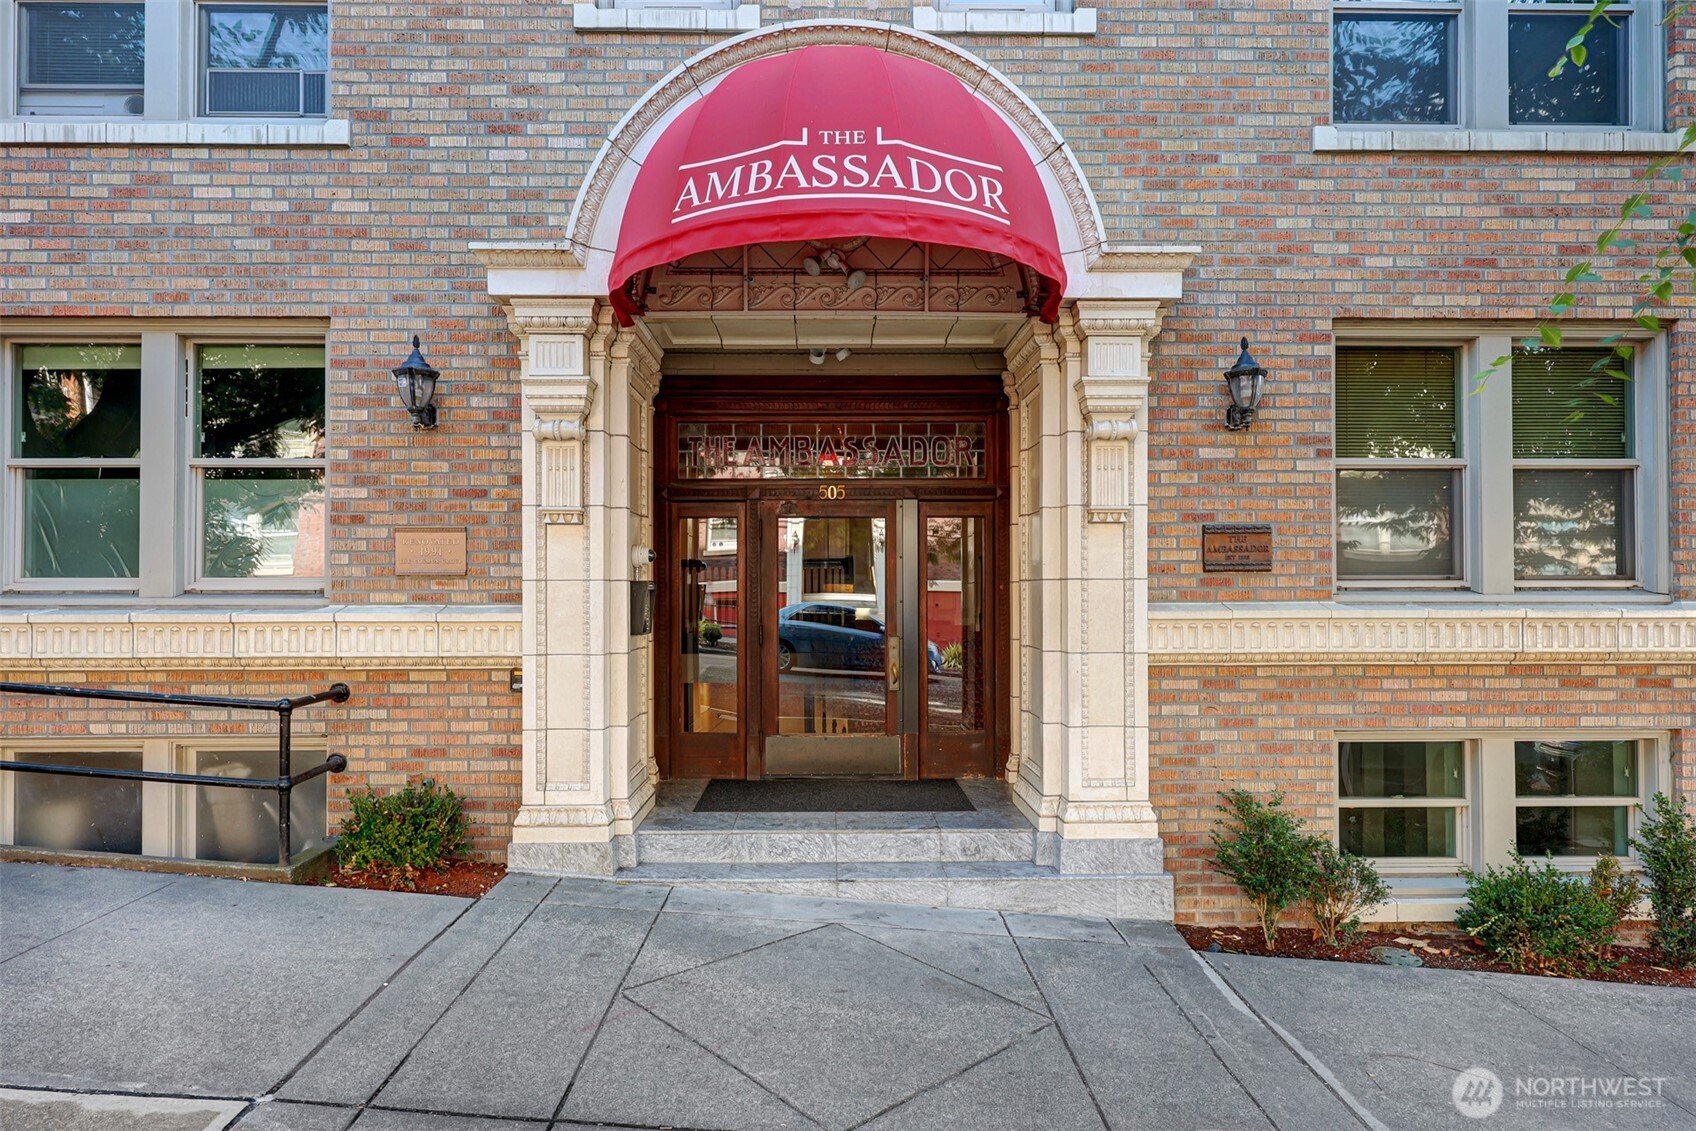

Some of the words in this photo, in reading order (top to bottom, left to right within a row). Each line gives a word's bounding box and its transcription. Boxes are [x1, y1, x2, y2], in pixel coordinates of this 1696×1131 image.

[818, 130, 866, 145] THE
[673, 154, 1010, 215] AMBASSADOR
[687, 435, 737, 467] THE
[743, 435, 976, 467] AMBASSADOR
[818, 485, 846, 500] 505
[402, 538, 460, 546] RENOVATED
[1227, 535, 1248, 543] THE
[420, 547, 443, 557] 1991
[1206, 545, 1270, 553] AMBASSADOR
